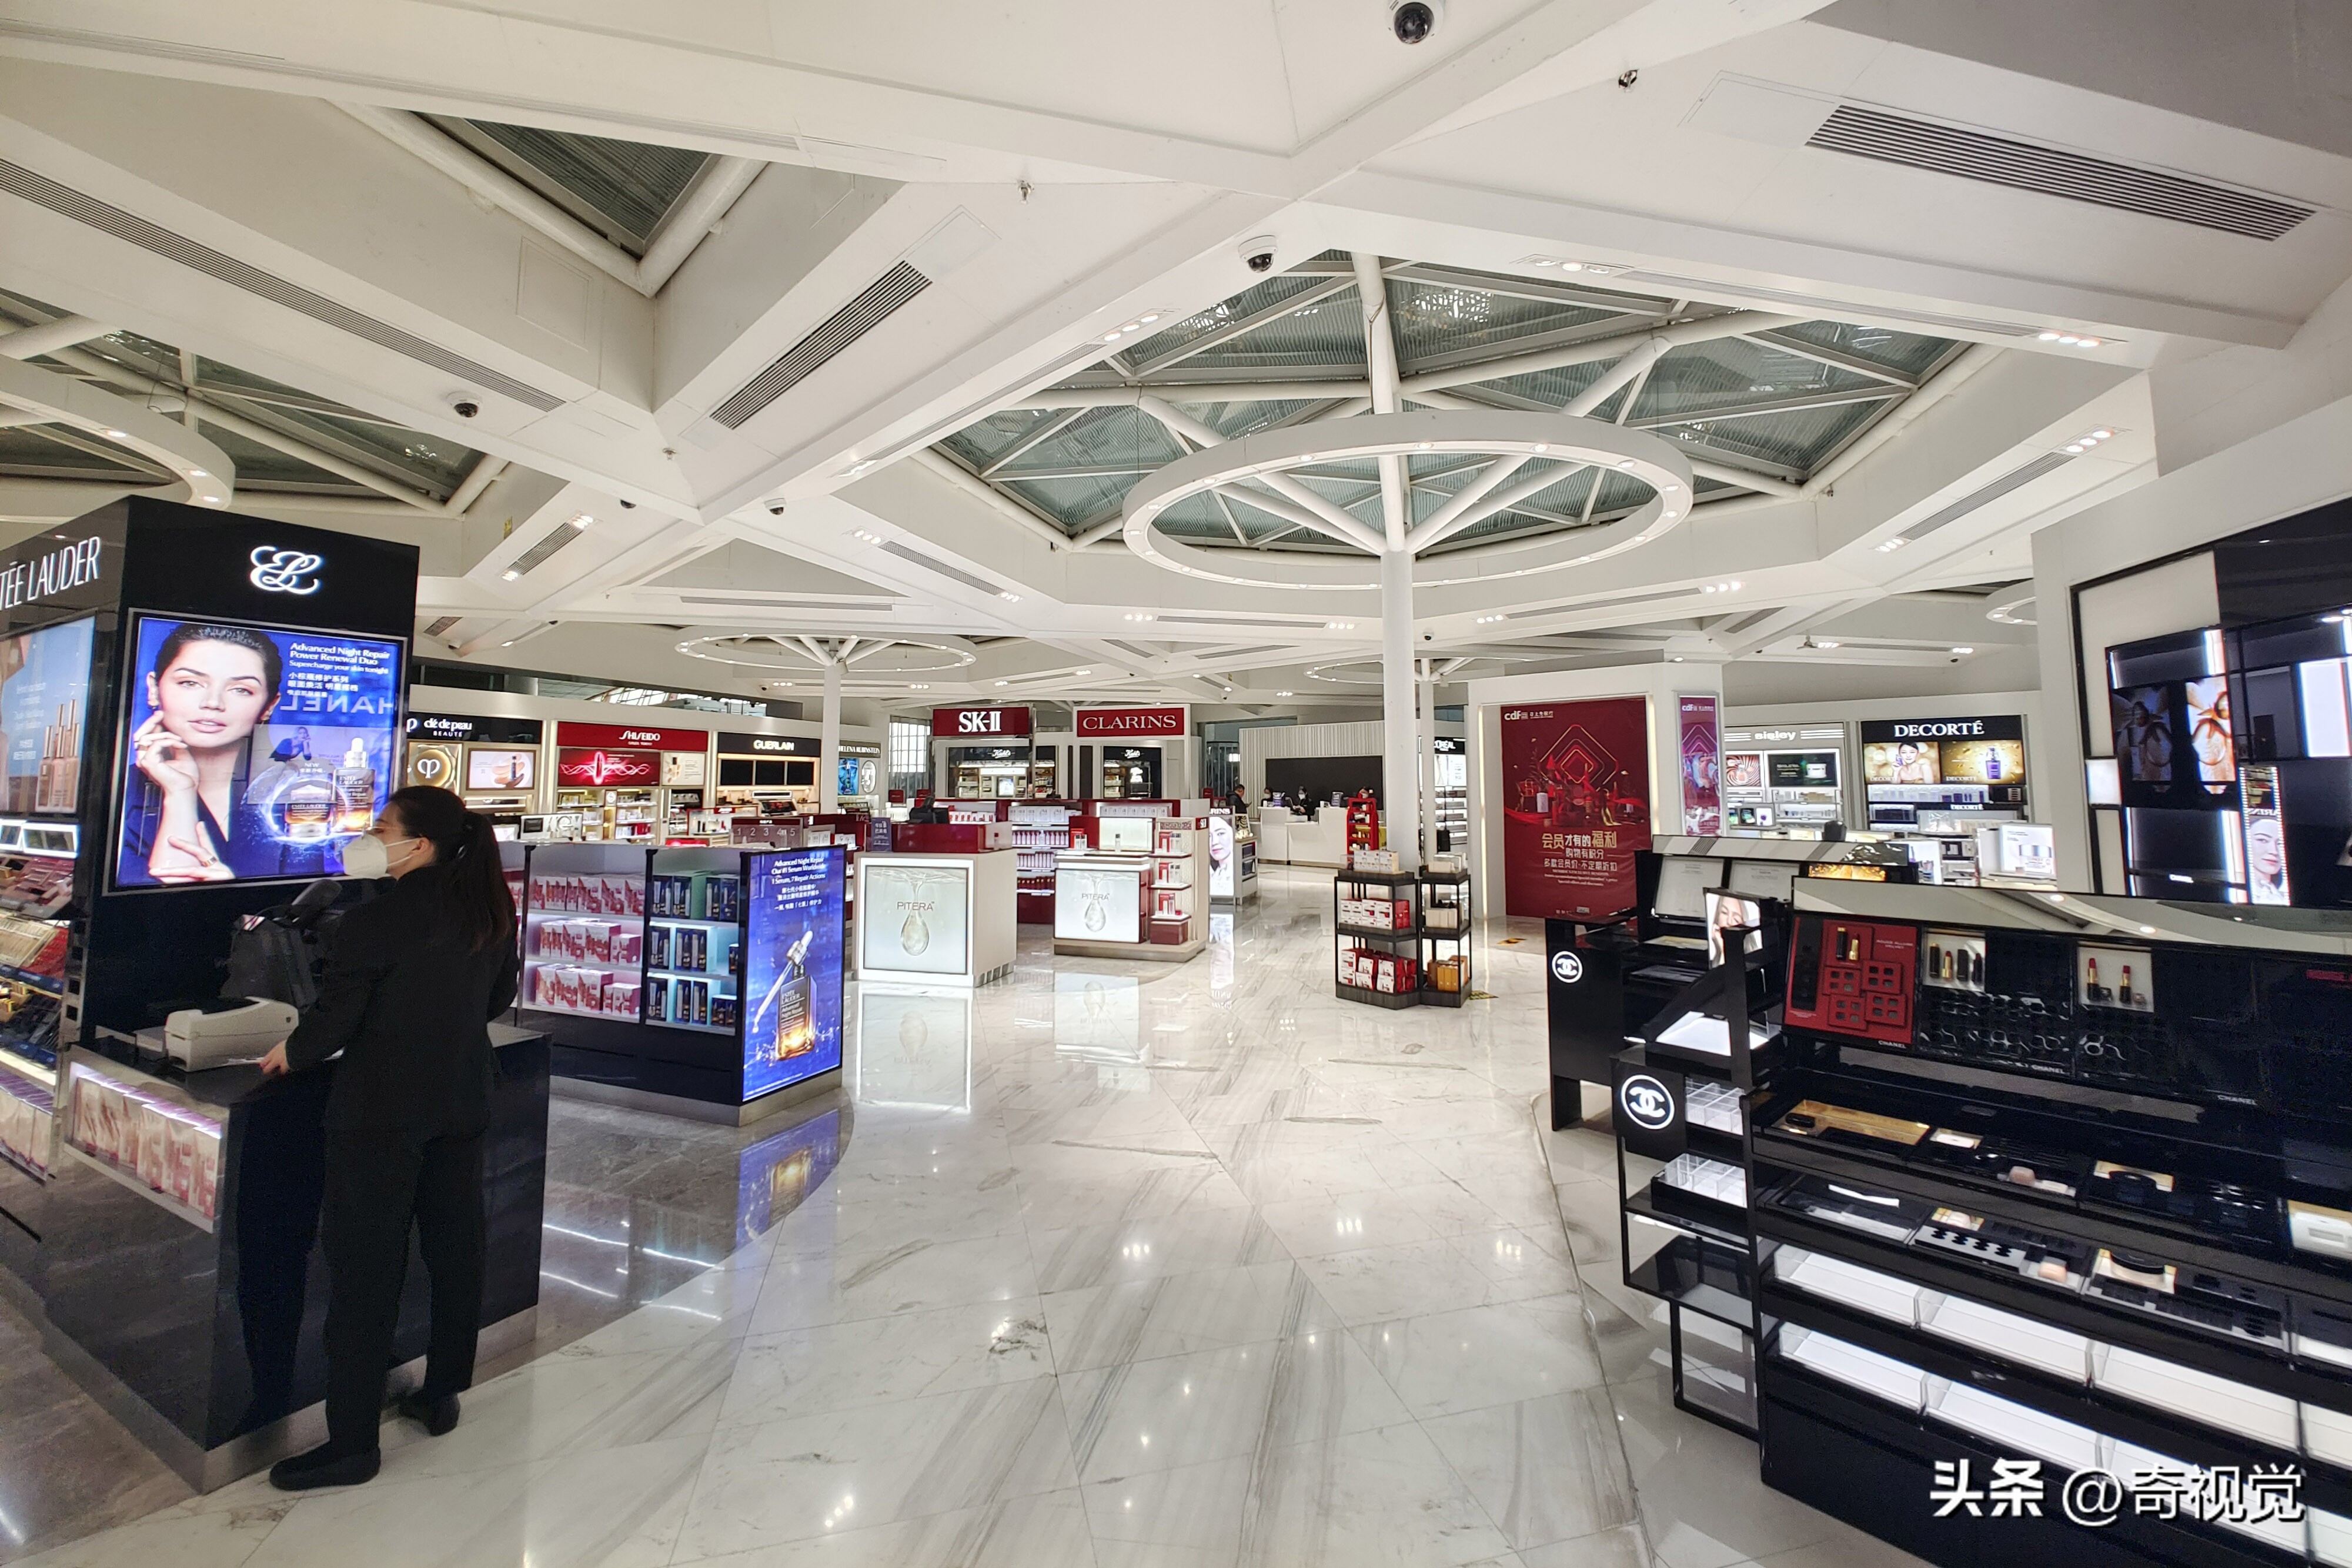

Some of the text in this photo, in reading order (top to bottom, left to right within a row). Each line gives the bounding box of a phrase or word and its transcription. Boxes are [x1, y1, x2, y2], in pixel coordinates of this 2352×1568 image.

[28, 536, 101, 601] LAUDER
[290, 643, 390, 659] Advanced Night Repair
[290, 651, 378, 665] Power Renewal Duo
[289, 660, 333, 670] Supercharge
[1504, 710, 1522, 721] cdf
[439, 719, 450, 729] de
[450, 721, 473, 731] peau
[958, 710, 1002, 733] SK-II
[1083, 715, 1176, 730] CLARINS
[1894, 720, 1985, 737] DECORTÉ
[619, 730, 660, 741] SHISEIDO
[1754, 730, 1796, 741] sisley
[753, 740, 794, 751] GUERLAIN
[737, 828, 741, 836] 1
[750, 828, 756, 836] 2
[764, 828, 769, 836] 3
[790, 828, 796, 837] 5
[1542, 830, 1617, 850] 会员才有的福利
[1565, 848, 1604, 860] 购物有积分
[810, 856, 824, 864] Repair
[897, 901, 934, 911] PITERA
[1878, 1040, 1907, 1049] CHANEL
[2031, 1064, 2065, 1075] CHANEL
[2217, 1095, 2258, 1106] CHANEL
